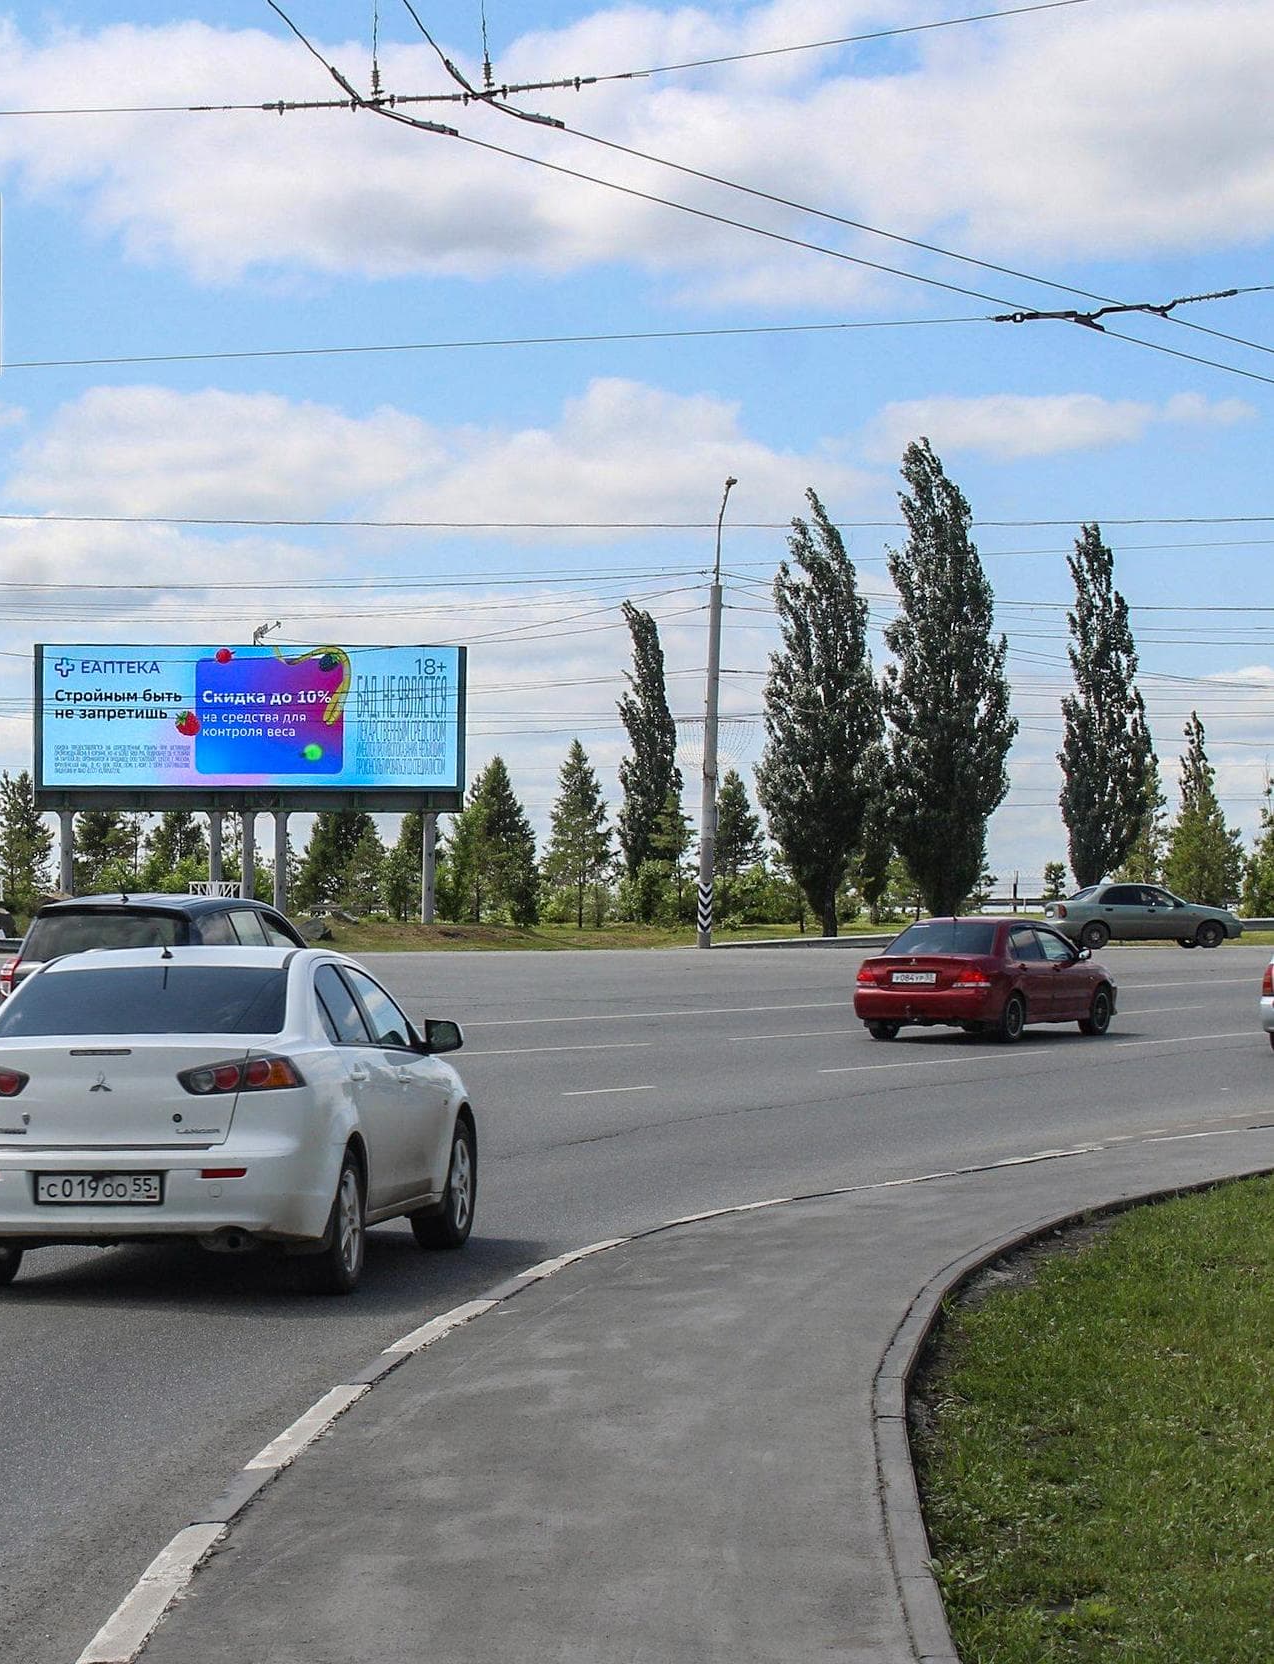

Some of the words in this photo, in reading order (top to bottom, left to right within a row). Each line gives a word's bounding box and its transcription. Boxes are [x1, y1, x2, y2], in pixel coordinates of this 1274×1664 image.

[81, 660, 161, 674] ЕАПТЕКА
[414, 658, 447, 675] 18+
[54, 689, 138, 703] Стройным
[142, 689, 183, 702] быть
[202, 690, 266, 705] Скидка
[269, 692, 293, 705] до
[296, 690, 332, 704] 10%
[54, 708, 74, 719] не
[78, 708, 168, 721] запретишь
[202, 713, 218, 723] на
[221, 713, 279, 724] средства
[282, 713, 307, 724] для
[202, 728, 263, 738] контроля
[267, 728, 296, 737] веса
[132, 1177, 153, 1193] 55
